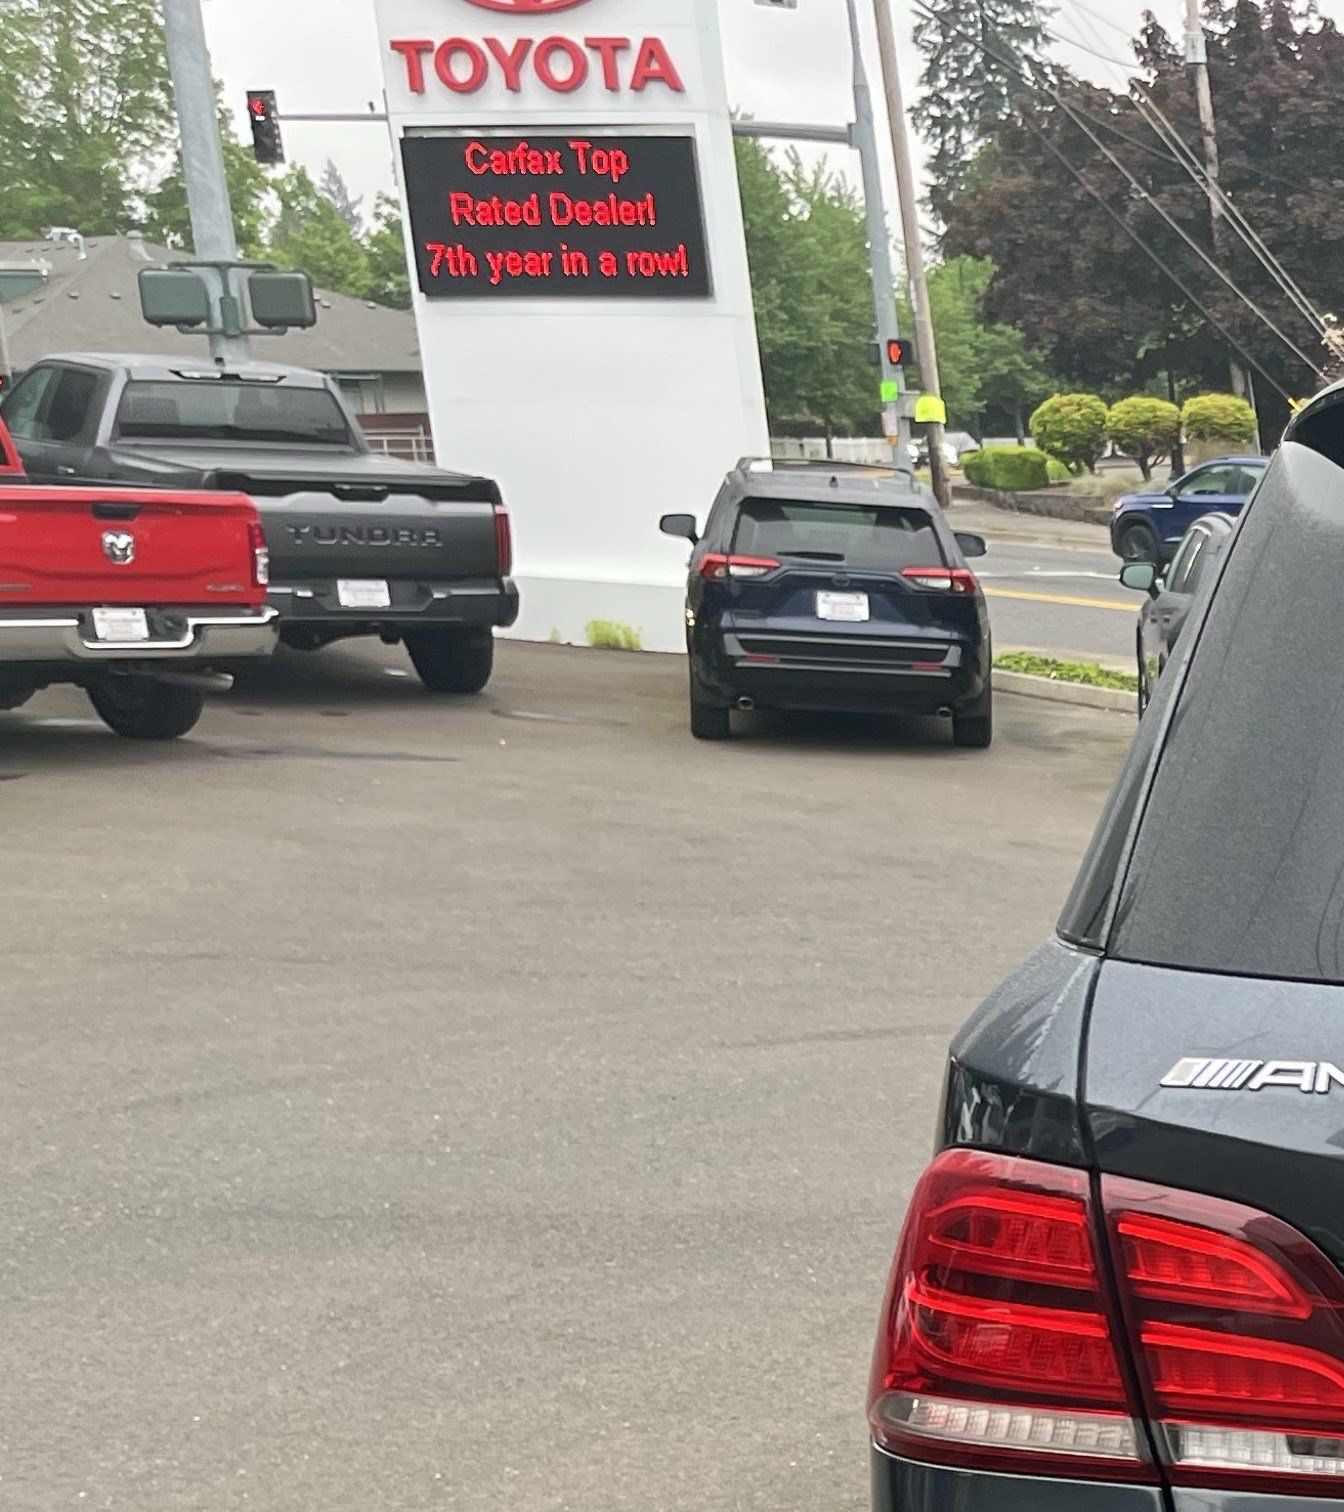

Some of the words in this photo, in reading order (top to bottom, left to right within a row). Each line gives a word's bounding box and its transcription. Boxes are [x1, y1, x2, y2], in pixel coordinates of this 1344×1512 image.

[390, 37, 686, 93] TOYOTA
[464, 141, 564, 175] Carfax
[569, 141, 629, 182] Top
[450, 192, 541, 225] Rated
[549, 192, 656, 225] Dealer!
[426, 242, 478, 277] 7th
[486, 250, 553, 285] year
[561, 243, 589, 277] in
[599, 251, 618, 277] a
[627, 244, 689, 277] row!
[285, 525, 444, 548] TUNDRA
